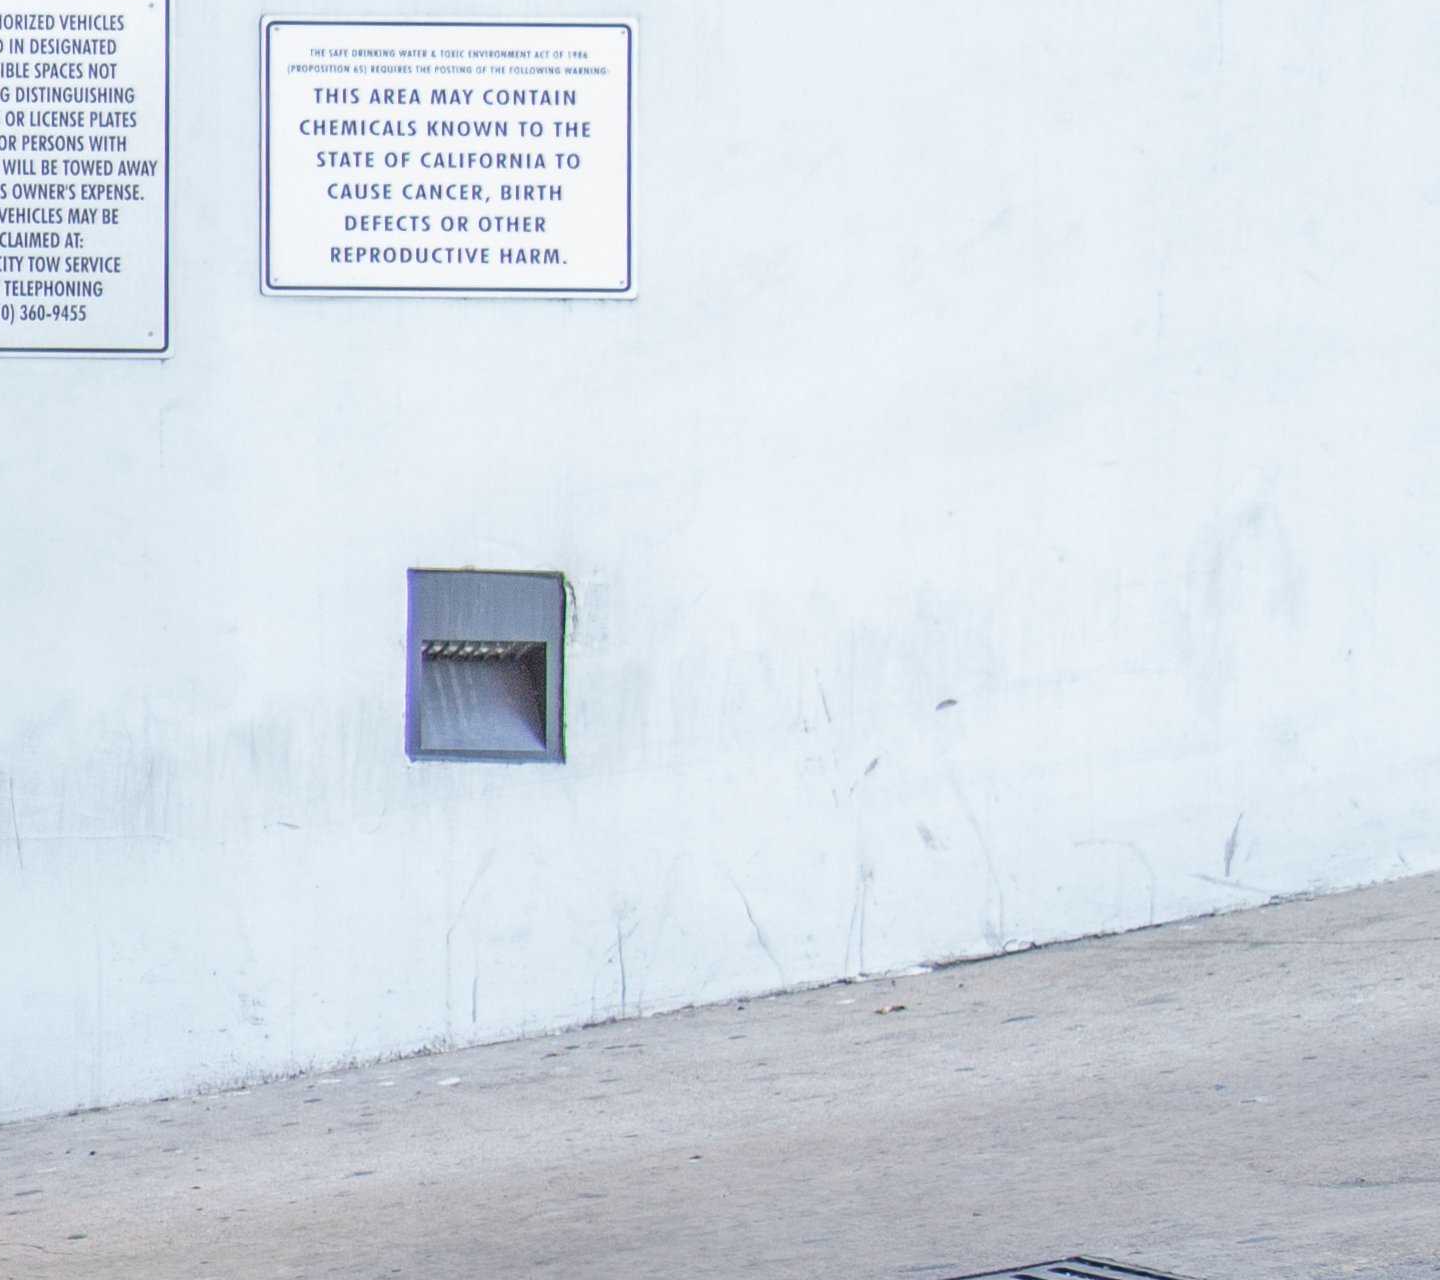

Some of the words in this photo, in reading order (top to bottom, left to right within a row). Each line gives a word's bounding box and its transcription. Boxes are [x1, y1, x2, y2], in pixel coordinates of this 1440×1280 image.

[59, 14, 124, 31] VEHICLES
[9, 38, 24, 54] IN
[30, 38, 117, 55] DESIGNATED
[34, 62, 83, 79] SPACES
[88, 63, 117, 79] NOT
[16, 86, 135, 104] DISTINGUISHING
[314, 88, 359, 104] THIS
[369, 88, 421, 104] AREA
[431, 89, 473, 105] MAY
[483, 89, 576, 106] CONTAIN
[5, 110, 25, 127] OR
[30, 111, 84, 127] LICENSE
[90, 111, 137, 128] PLATES
[299, 119, 417, 136] CHEMICALS
[427, 121, 507, 137] KNOWN
[519, 121, 543, 137] TO
[554, 122, 590, 138] THE
[22, 135, 84, 152] PERSONS
[89, 136, 126, 152] WITH
[2, 159, 36, 175] WILL
[41, 159, 58, 176] BE
[62, 159, 113, 176] TOWED
[118, 160, 157, 176] AWAY
[317, 151, 374, 168] STATE
[384, 152, 410, 168] OF
[420, 152, 546, 169] CALIFORNIA
[555, 153, 580, 169] TO
[12, 183, 76, 200] OWNER'S
[81, 184, 144, 201] EXPENSE.
[327, 183, 391, 200] CAUSE
[402, 184, 490, 203] CANCER,
[501, 185, 562, 201] BIRTH
[68, 208, 98, 224] MAY
[102, 208, 118, 225] BE
[345, 215, 430, 232] DEFECTS
[441, 216, 468, 232] OR
[478, 216, 545, 232] OTHER
[64, 232, 84, 248] AT:
[331, 247, 489, 264] REPRODUCTIVE
[500, 248, 567, 264] HARM.
[28, 256, 61, 272] TOW
[65, 256, 120, 273] SERVICE
[4, 280, 103, 297] TELEPHONING
[20, 304, 86, 321] 360-9455
